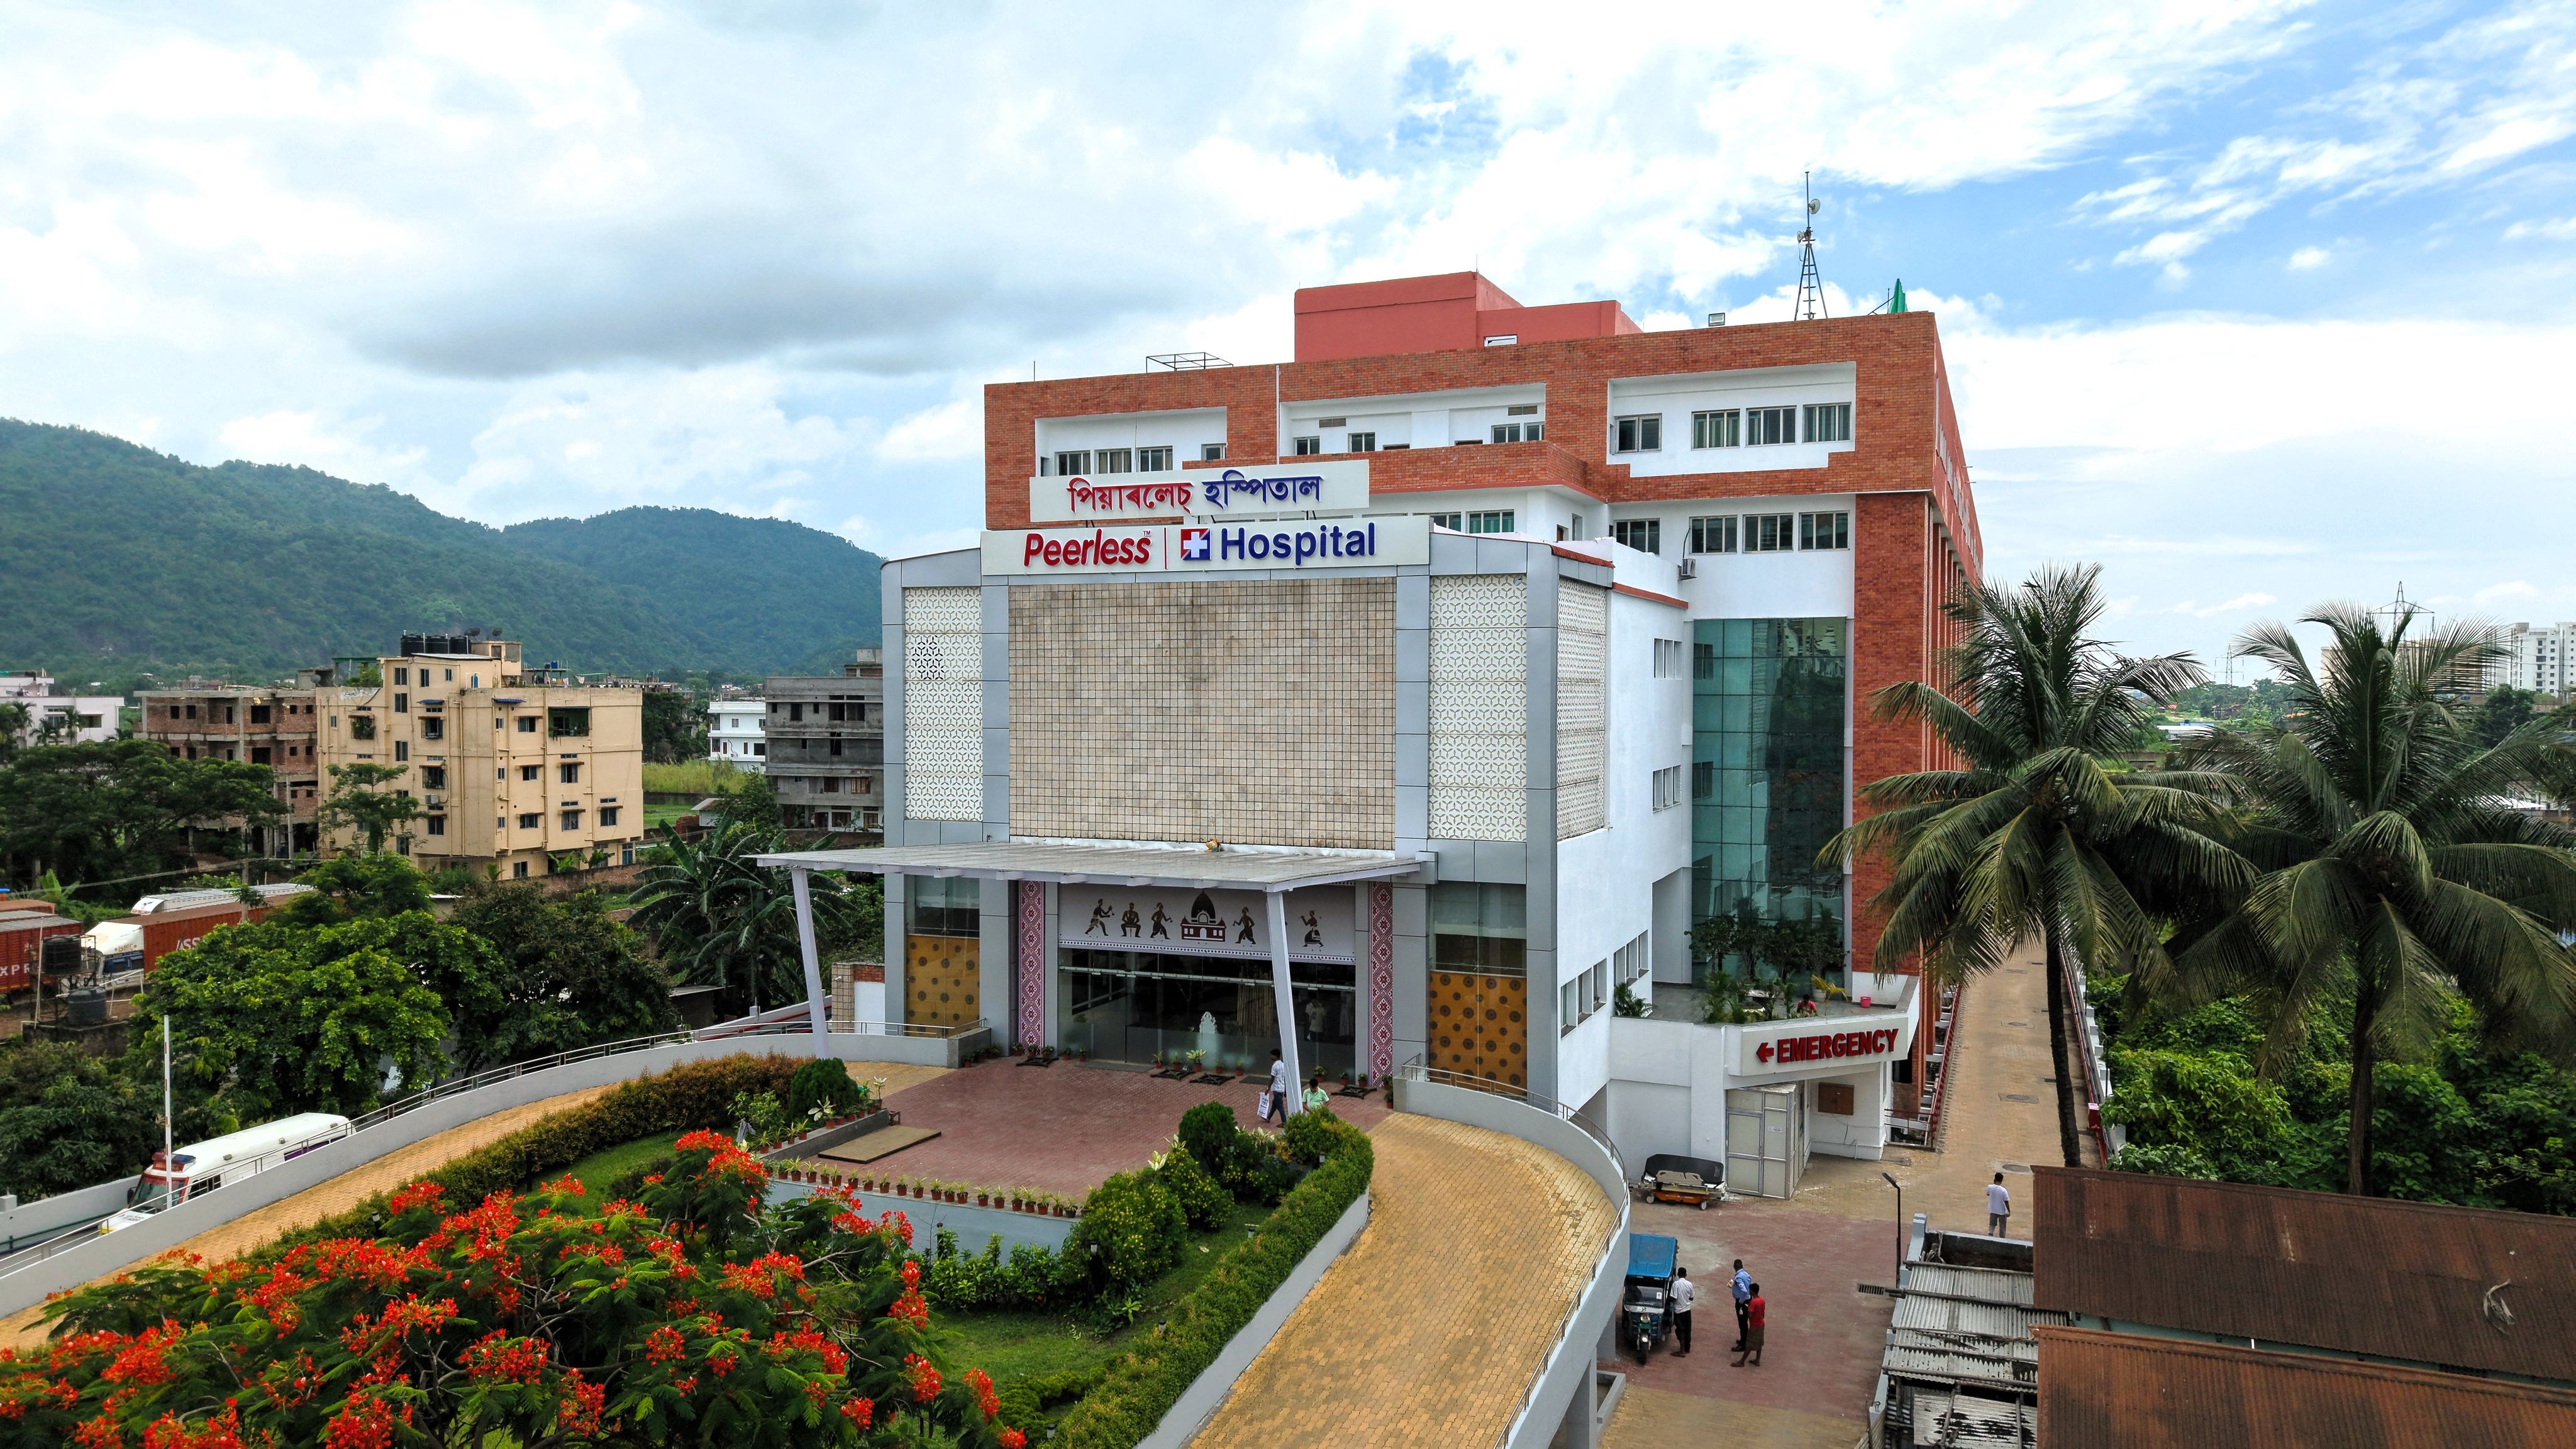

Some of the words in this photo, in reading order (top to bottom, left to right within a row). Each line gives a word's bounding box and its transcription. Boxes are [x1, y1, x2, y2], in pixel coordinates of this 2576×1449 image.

[1201, 469, 1324, 510] হস্পিতাল
[1023, 528, 1152, 567] Peerless
[1221, 522, 1376, 567] Hospital
[1777, 1028, 1899, 1063] EMERGENCY
